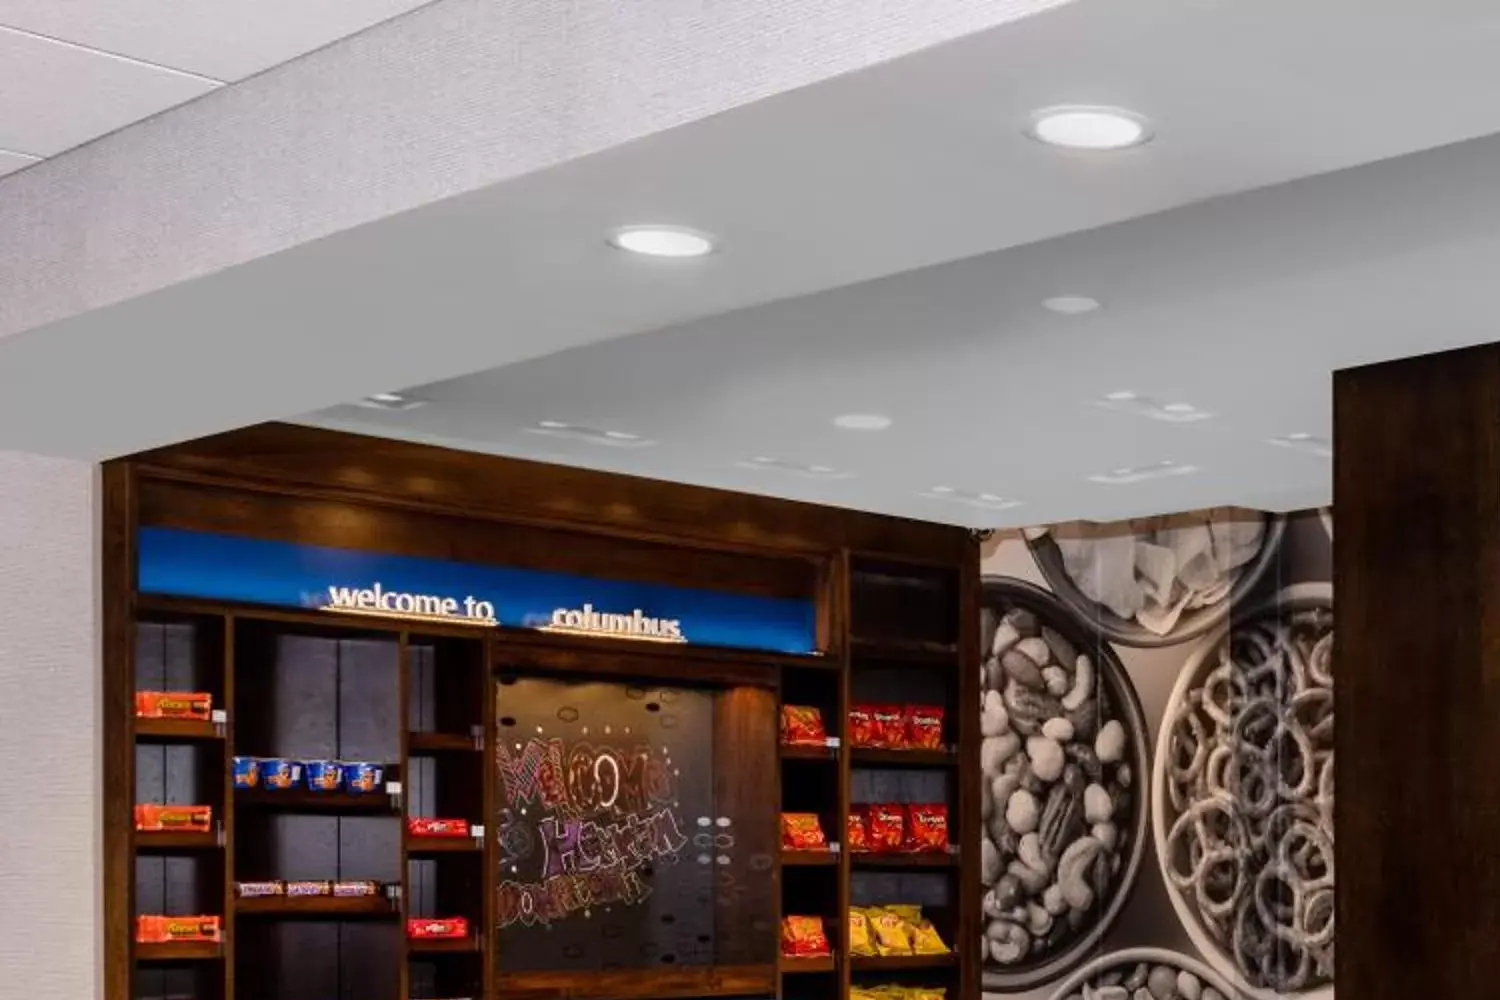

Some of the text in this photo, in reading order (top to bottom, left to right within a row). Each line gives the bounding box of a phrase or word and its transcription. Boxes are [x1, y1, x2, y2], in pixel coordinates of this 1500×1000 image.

[328, 581, 496, 620] welcome to
[551, 604, 682, 637] columbus
